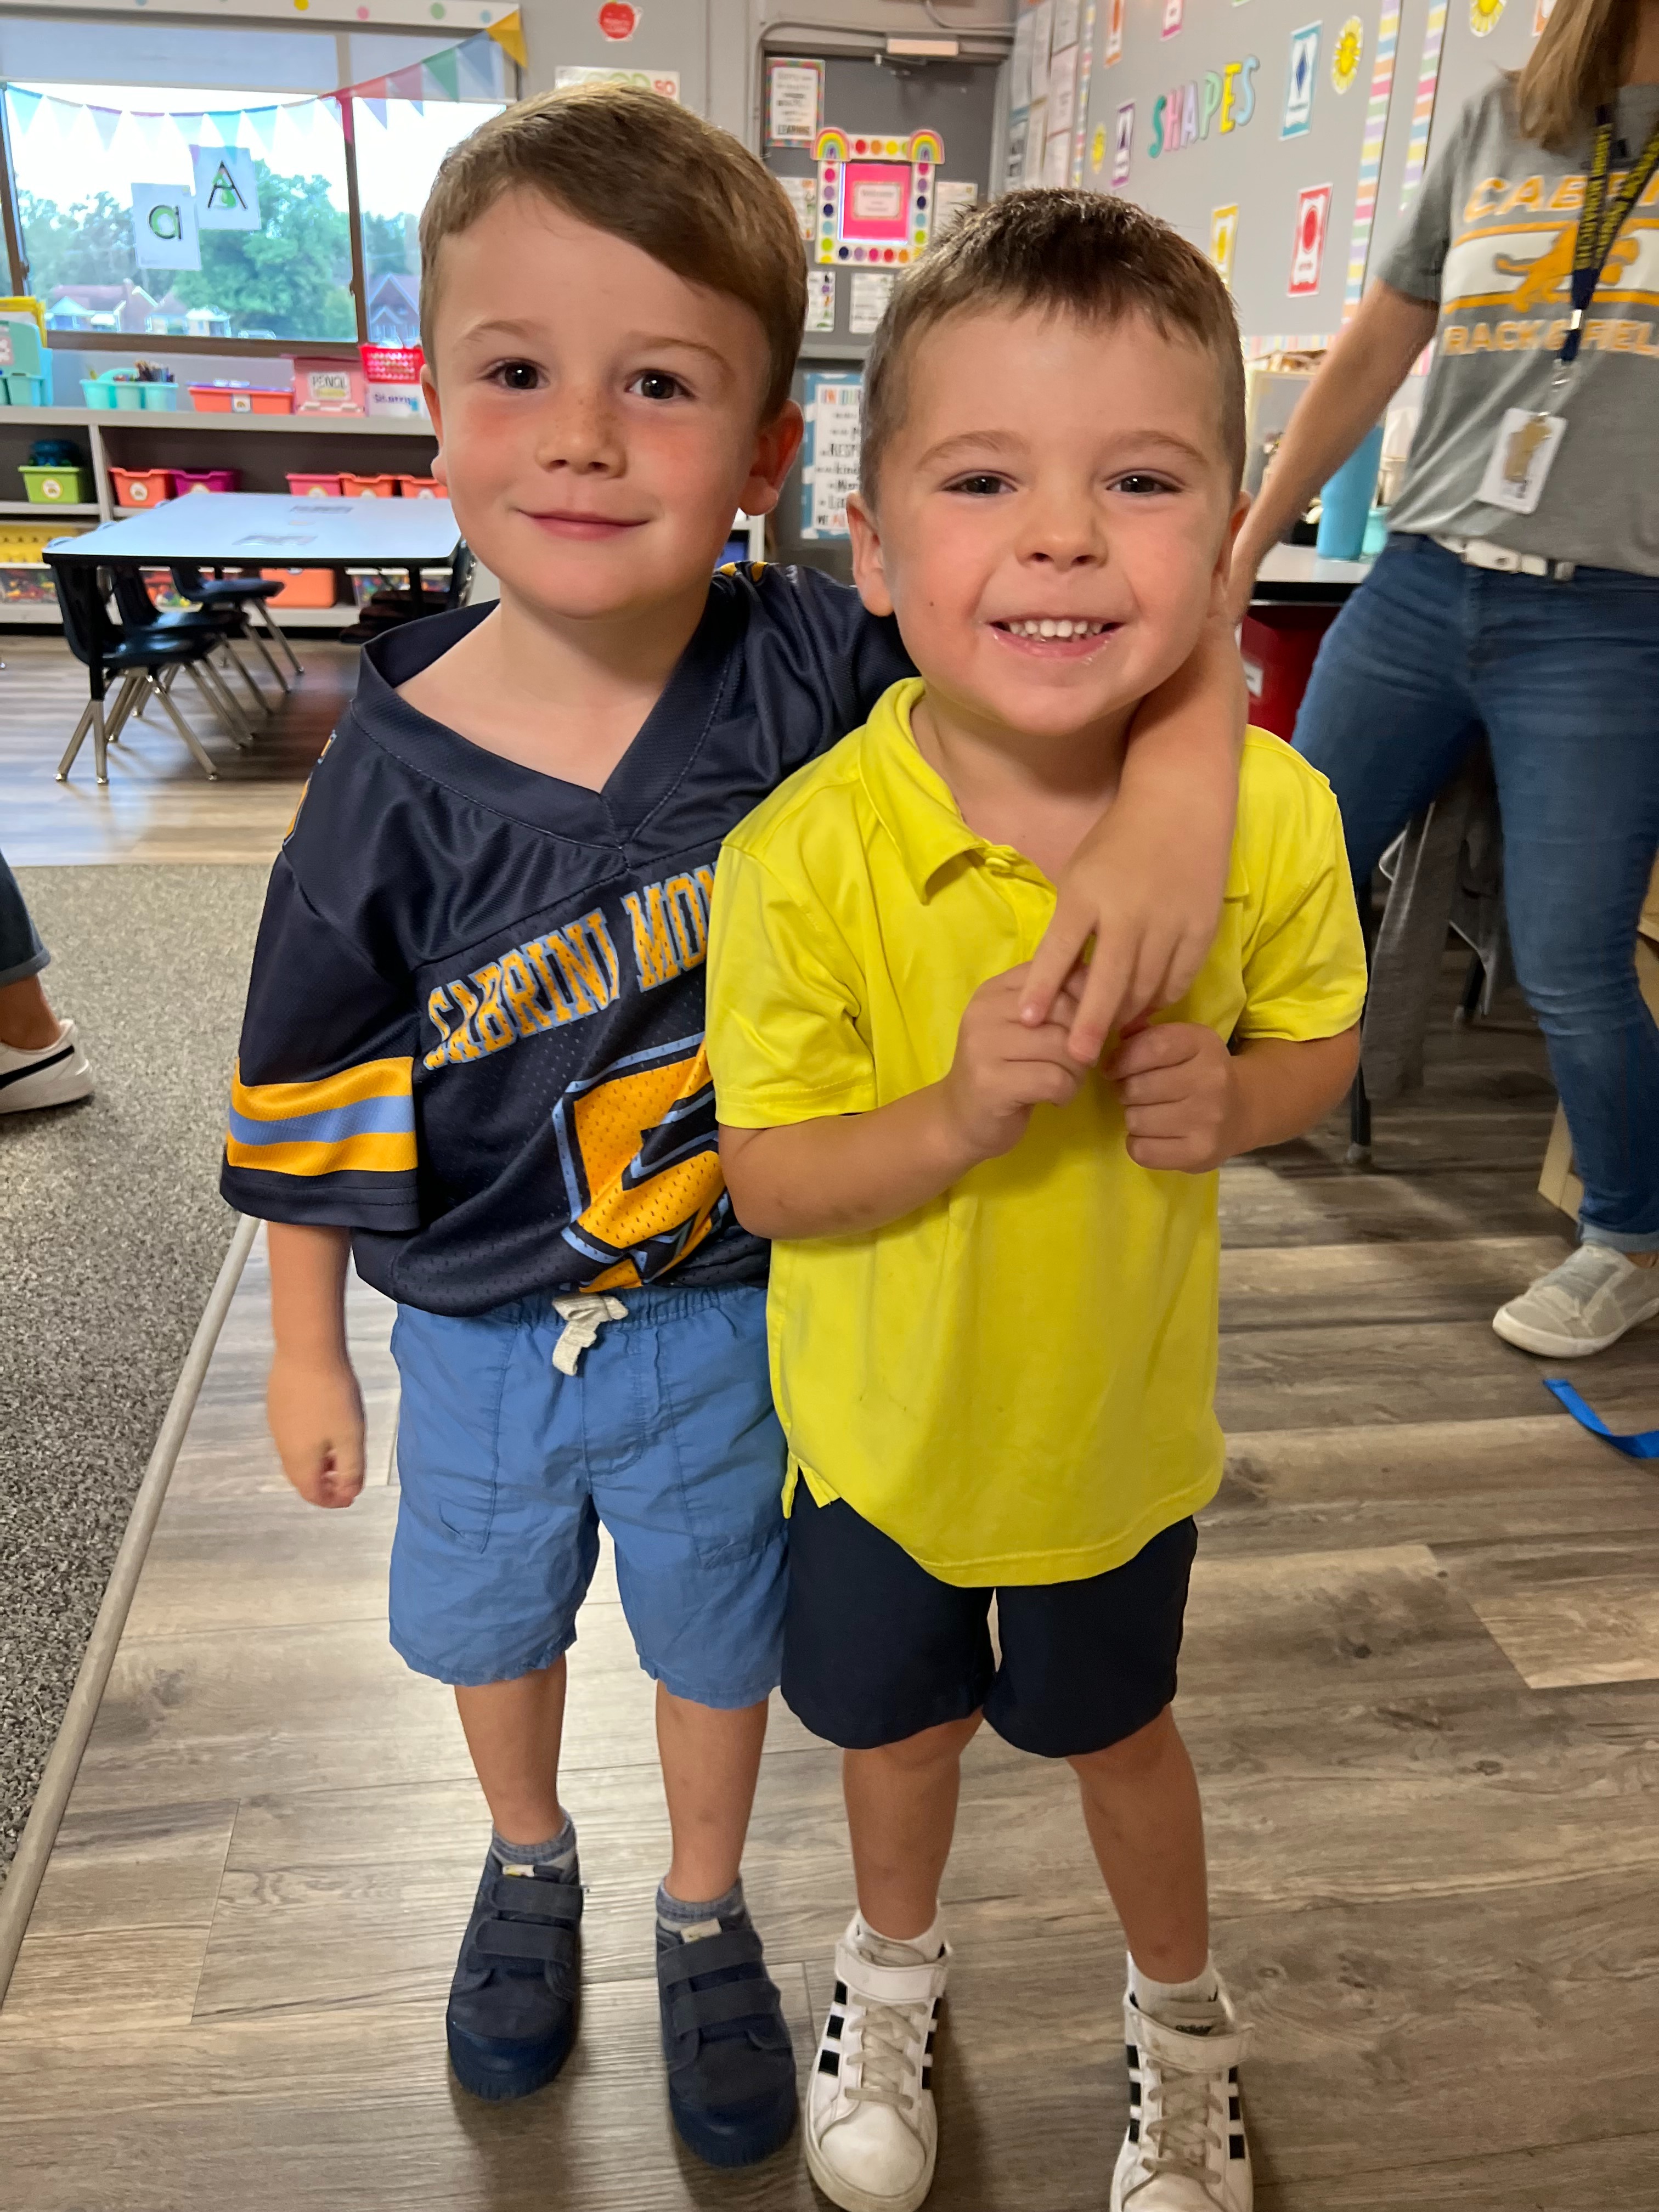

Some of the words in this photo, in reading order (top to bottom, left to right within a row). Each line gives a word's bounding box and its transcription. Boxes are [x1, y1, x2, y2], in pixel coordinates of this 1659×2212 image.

[1148, 54, 1260, 159] SHAPES
[148, 204, 182, 240] a
[207, 160, 247, 210] A
[422, 907, 620, 1070] CABRINI
[619, 860, 718, 993] MO
